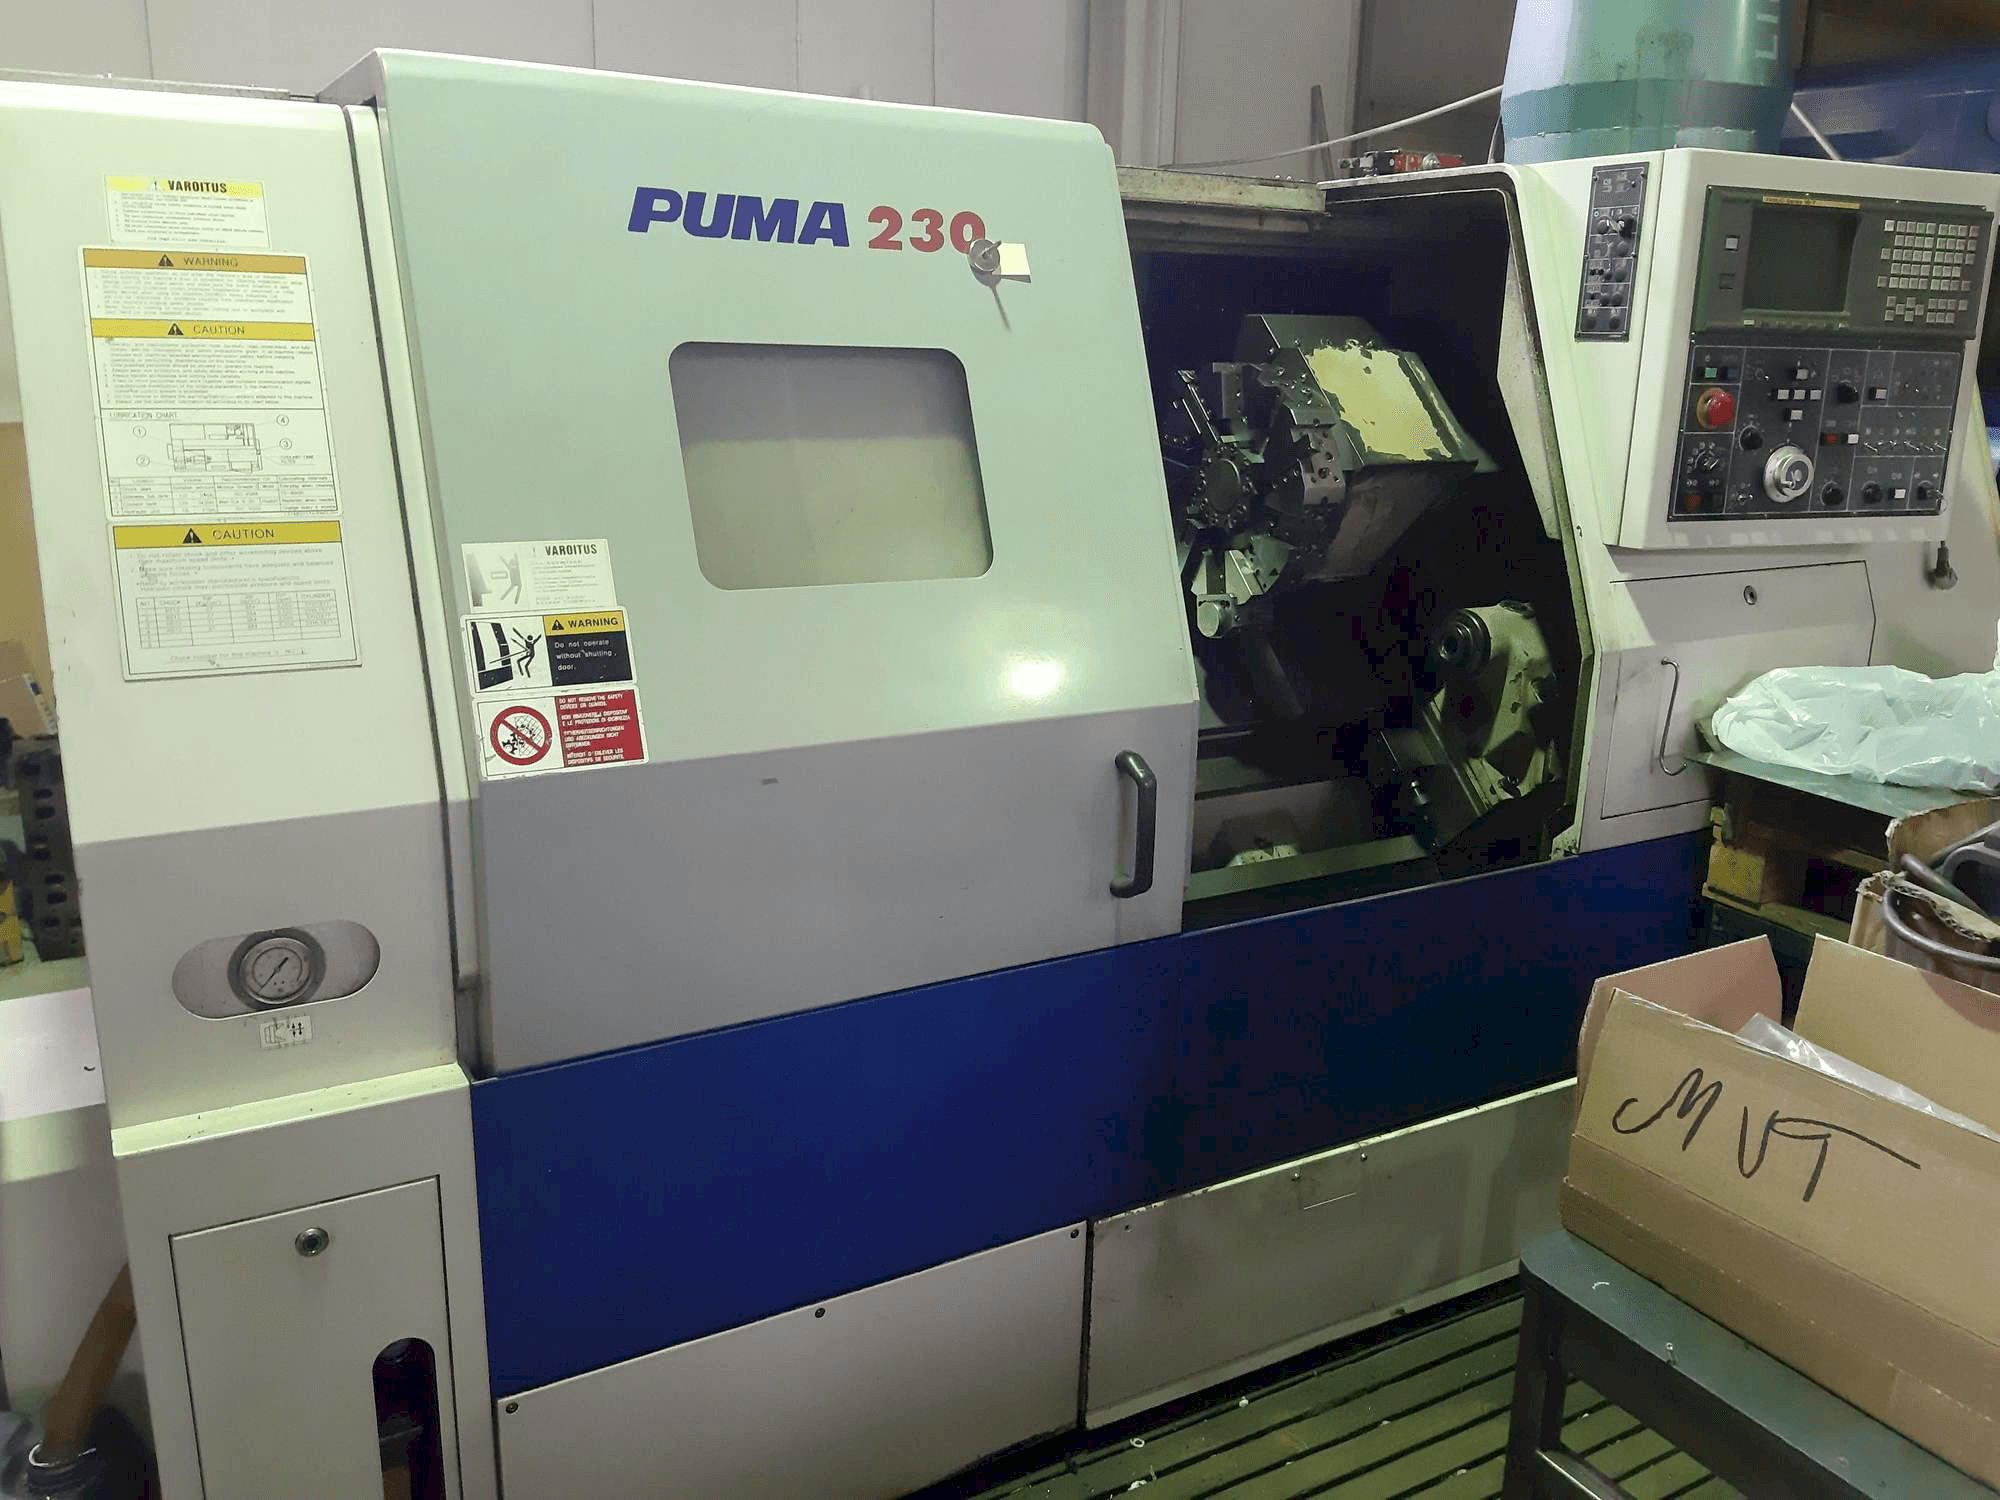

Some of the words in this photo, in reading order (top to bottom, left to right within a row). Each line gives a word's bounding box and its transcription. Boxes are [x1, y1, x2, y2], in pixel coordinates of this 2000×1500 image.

[167, 180, 228, 194] VAROITUS
[627, 186, 850, 248] PUMA
[868, 205, 986, 255] 230
[183, 256, 238, 268] WARNING
[193, 325, 246, 336] CAUTION
[212, 528, 275, 540] CAUTION
[545, 543, 598, 556] VAROITUS
[568, 617, 619, 628] WARNING
[554, 640, 565, 649] Do
[568, 640, 580, 648] not
[584, 639, 610, 648] operate
[556, 652, 581, 660] without
